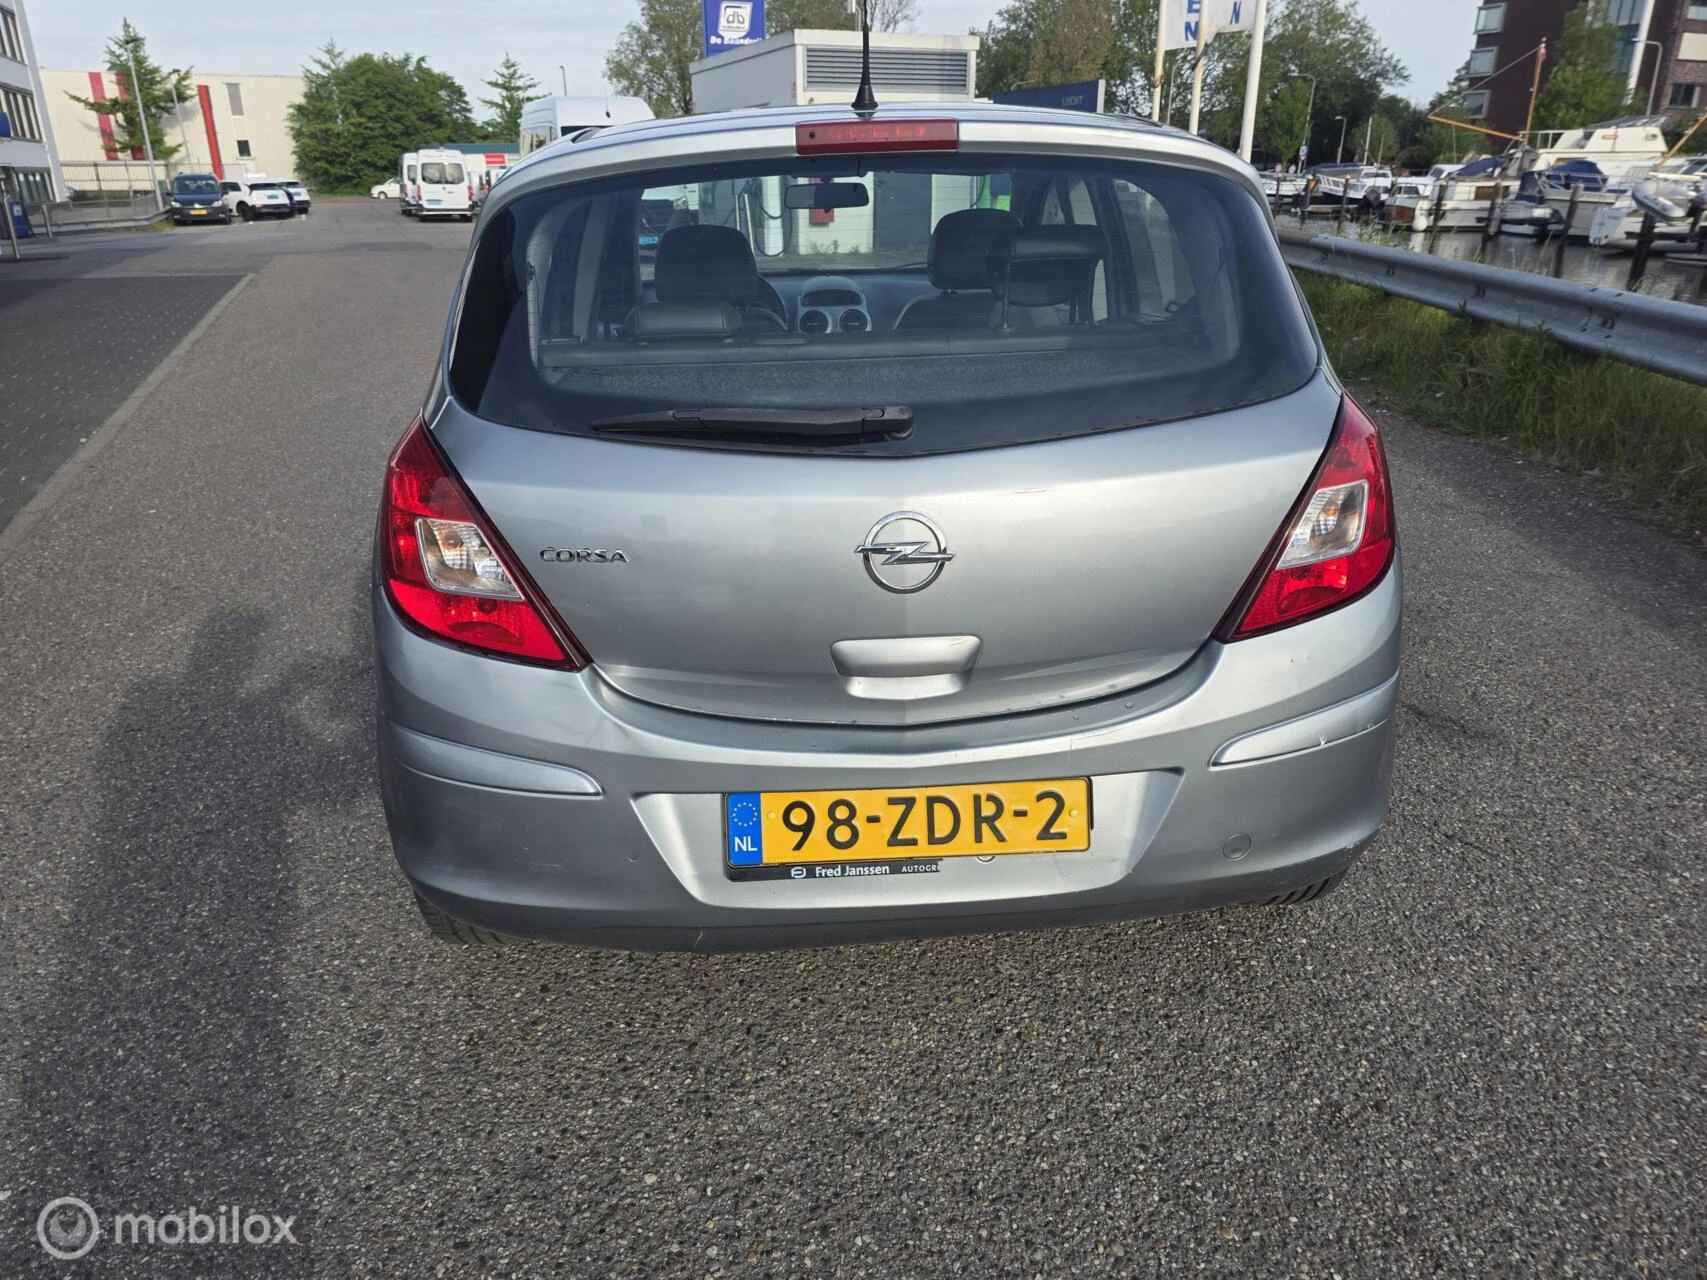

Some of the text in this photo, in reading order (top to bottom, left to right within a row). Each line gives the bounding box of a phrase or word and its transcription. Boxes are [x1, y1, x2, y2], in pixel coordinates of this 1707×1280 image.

[710, 36, 722, 44] De
[1062, 95, 1083, 106] LUCHT
[540, 547, 629, 563] CORSA
[734, 791, 1068, 852] NL 98-ZDR-2
[815, 865, 841, 877] Fred
[844, 865, 890, 876] Janssen
